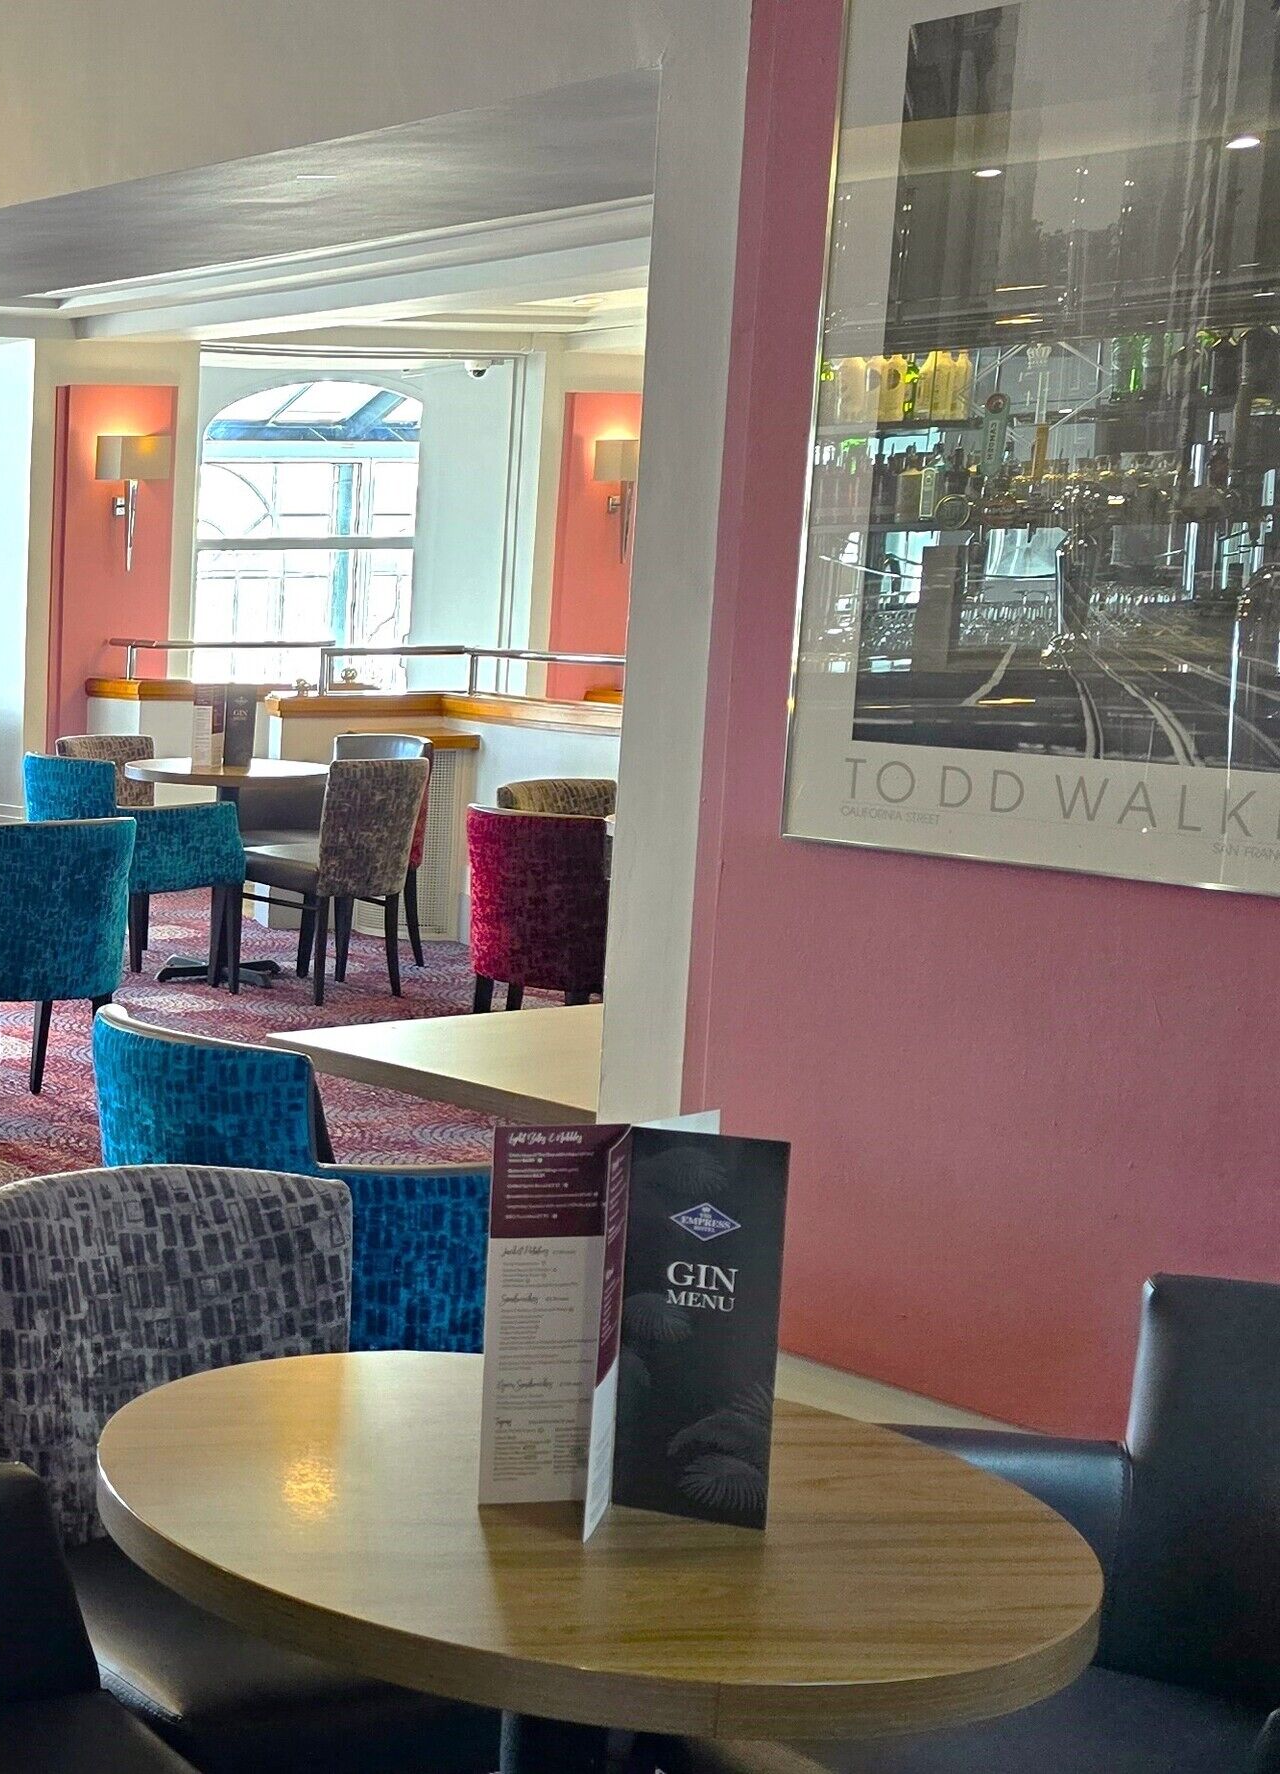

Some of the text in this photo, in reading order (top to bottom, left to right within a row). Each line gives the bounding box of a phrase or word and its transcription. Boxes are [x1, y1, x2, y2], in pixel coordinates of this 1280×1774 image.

[844, 758, 1025, 813] TODD
[841, 805, 941, 825] CALIFORNIA STREET
[1212, 841, 1239, 857] SAN
[680, 1215, 732, 1229] EMPRESS
[666, 1261, 739, 1293] GIN
[666, 1289, 736, 1312] MENU
